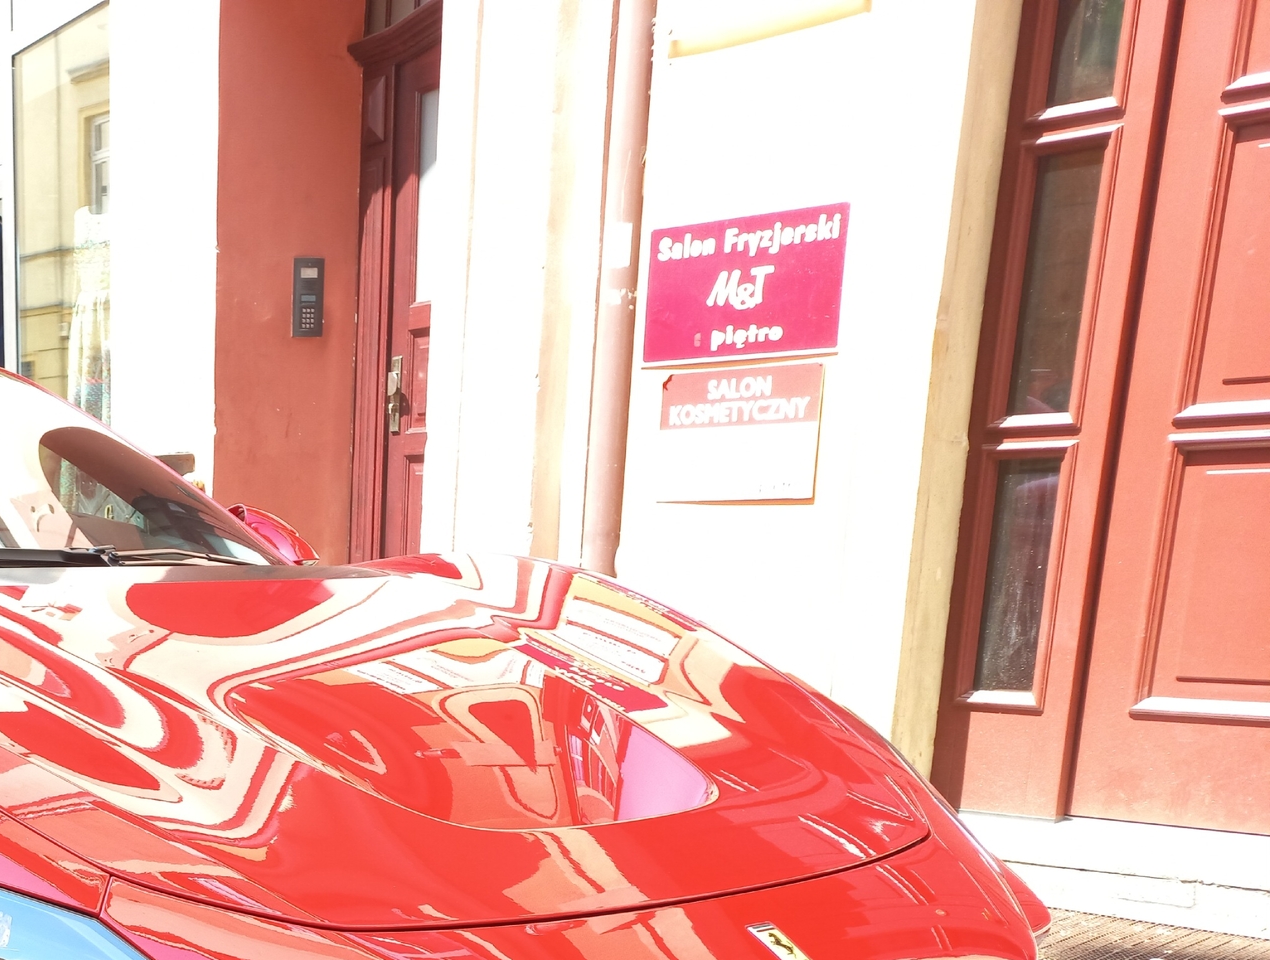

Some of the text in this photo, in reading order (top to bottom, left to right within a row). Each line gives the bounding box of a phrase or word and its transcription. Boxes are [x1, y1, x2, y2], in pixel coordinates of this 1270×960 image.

[658, 214, 841, 261] Salon Fryzjerski
[706, 266, 775, 310] M&T
[711, 326, 783, 350] piętro
[708, 377, 772, 398] SALON
[669, 397, 810, 426] KOSMETYCZNY
